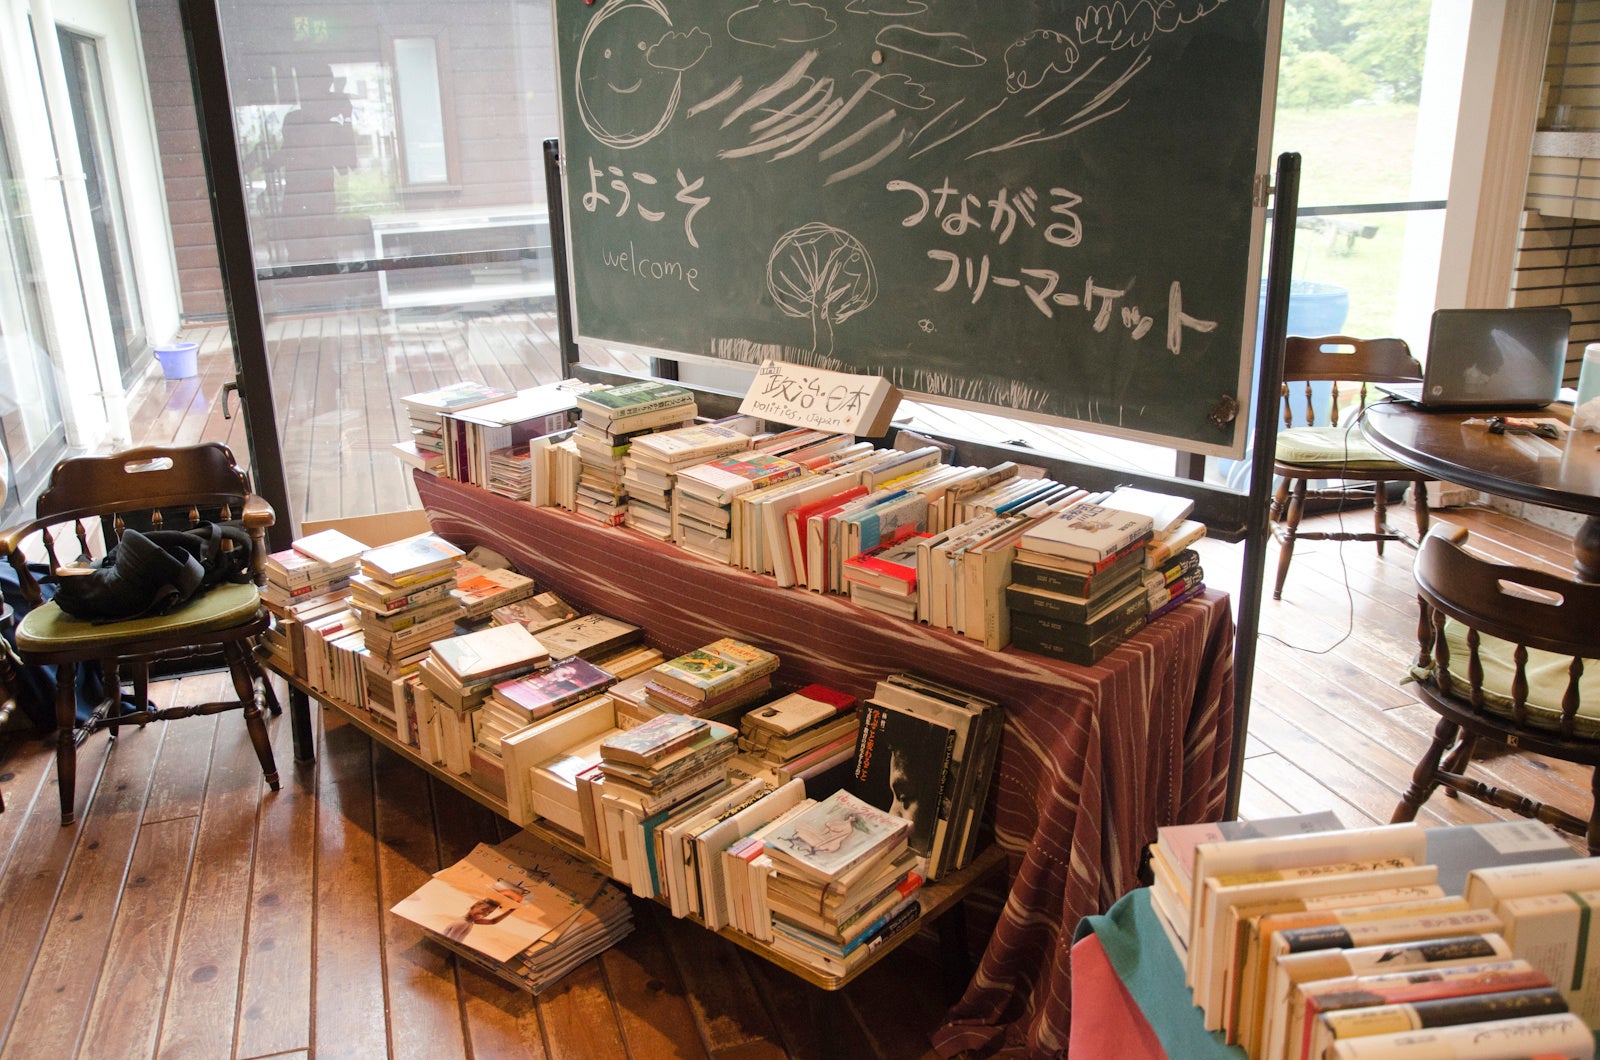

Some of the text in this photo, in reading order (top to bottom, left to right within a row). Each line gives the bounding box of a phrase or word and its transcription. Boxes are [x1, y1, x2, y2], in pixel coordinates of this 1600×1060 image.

[582, 156, 711, 248] ようこそ
[886, 176, 1083, 247] つながる
[602, 240, 700, 292] welcome
[927, 249, 1218, 355] フリーマーケット
[752, 399, 840, 427] politics, Japan
